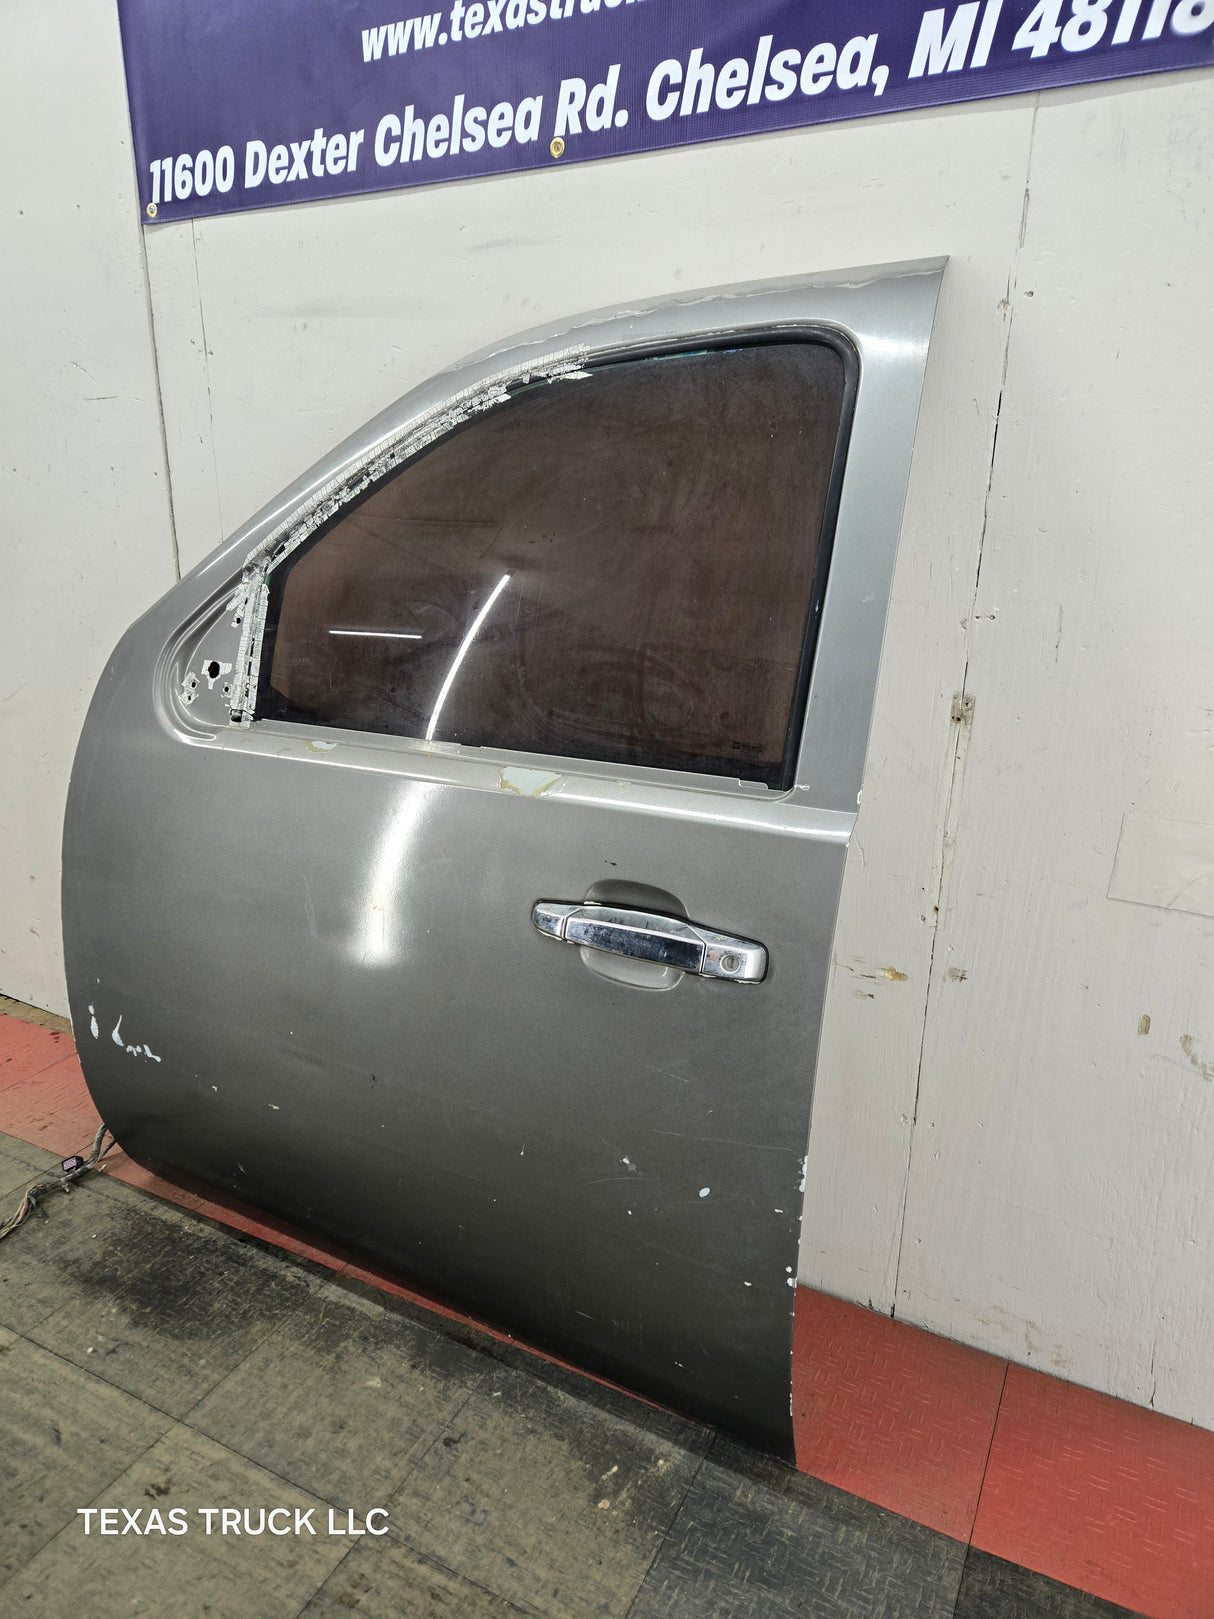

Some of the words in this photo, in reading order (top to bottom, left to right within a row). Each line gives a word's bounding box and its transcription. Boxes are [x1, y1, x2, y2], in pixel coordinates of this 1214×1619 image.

[149, 145, 235, 204] 11600
[244, 127, 365, 189] Dexter
[374, 94, 544, 167] Chelsea
[553, 63, 629, 138] Rd.
[645, 33, 890, 121] Chelsea,
[908, 0, 1004, 79] MI
